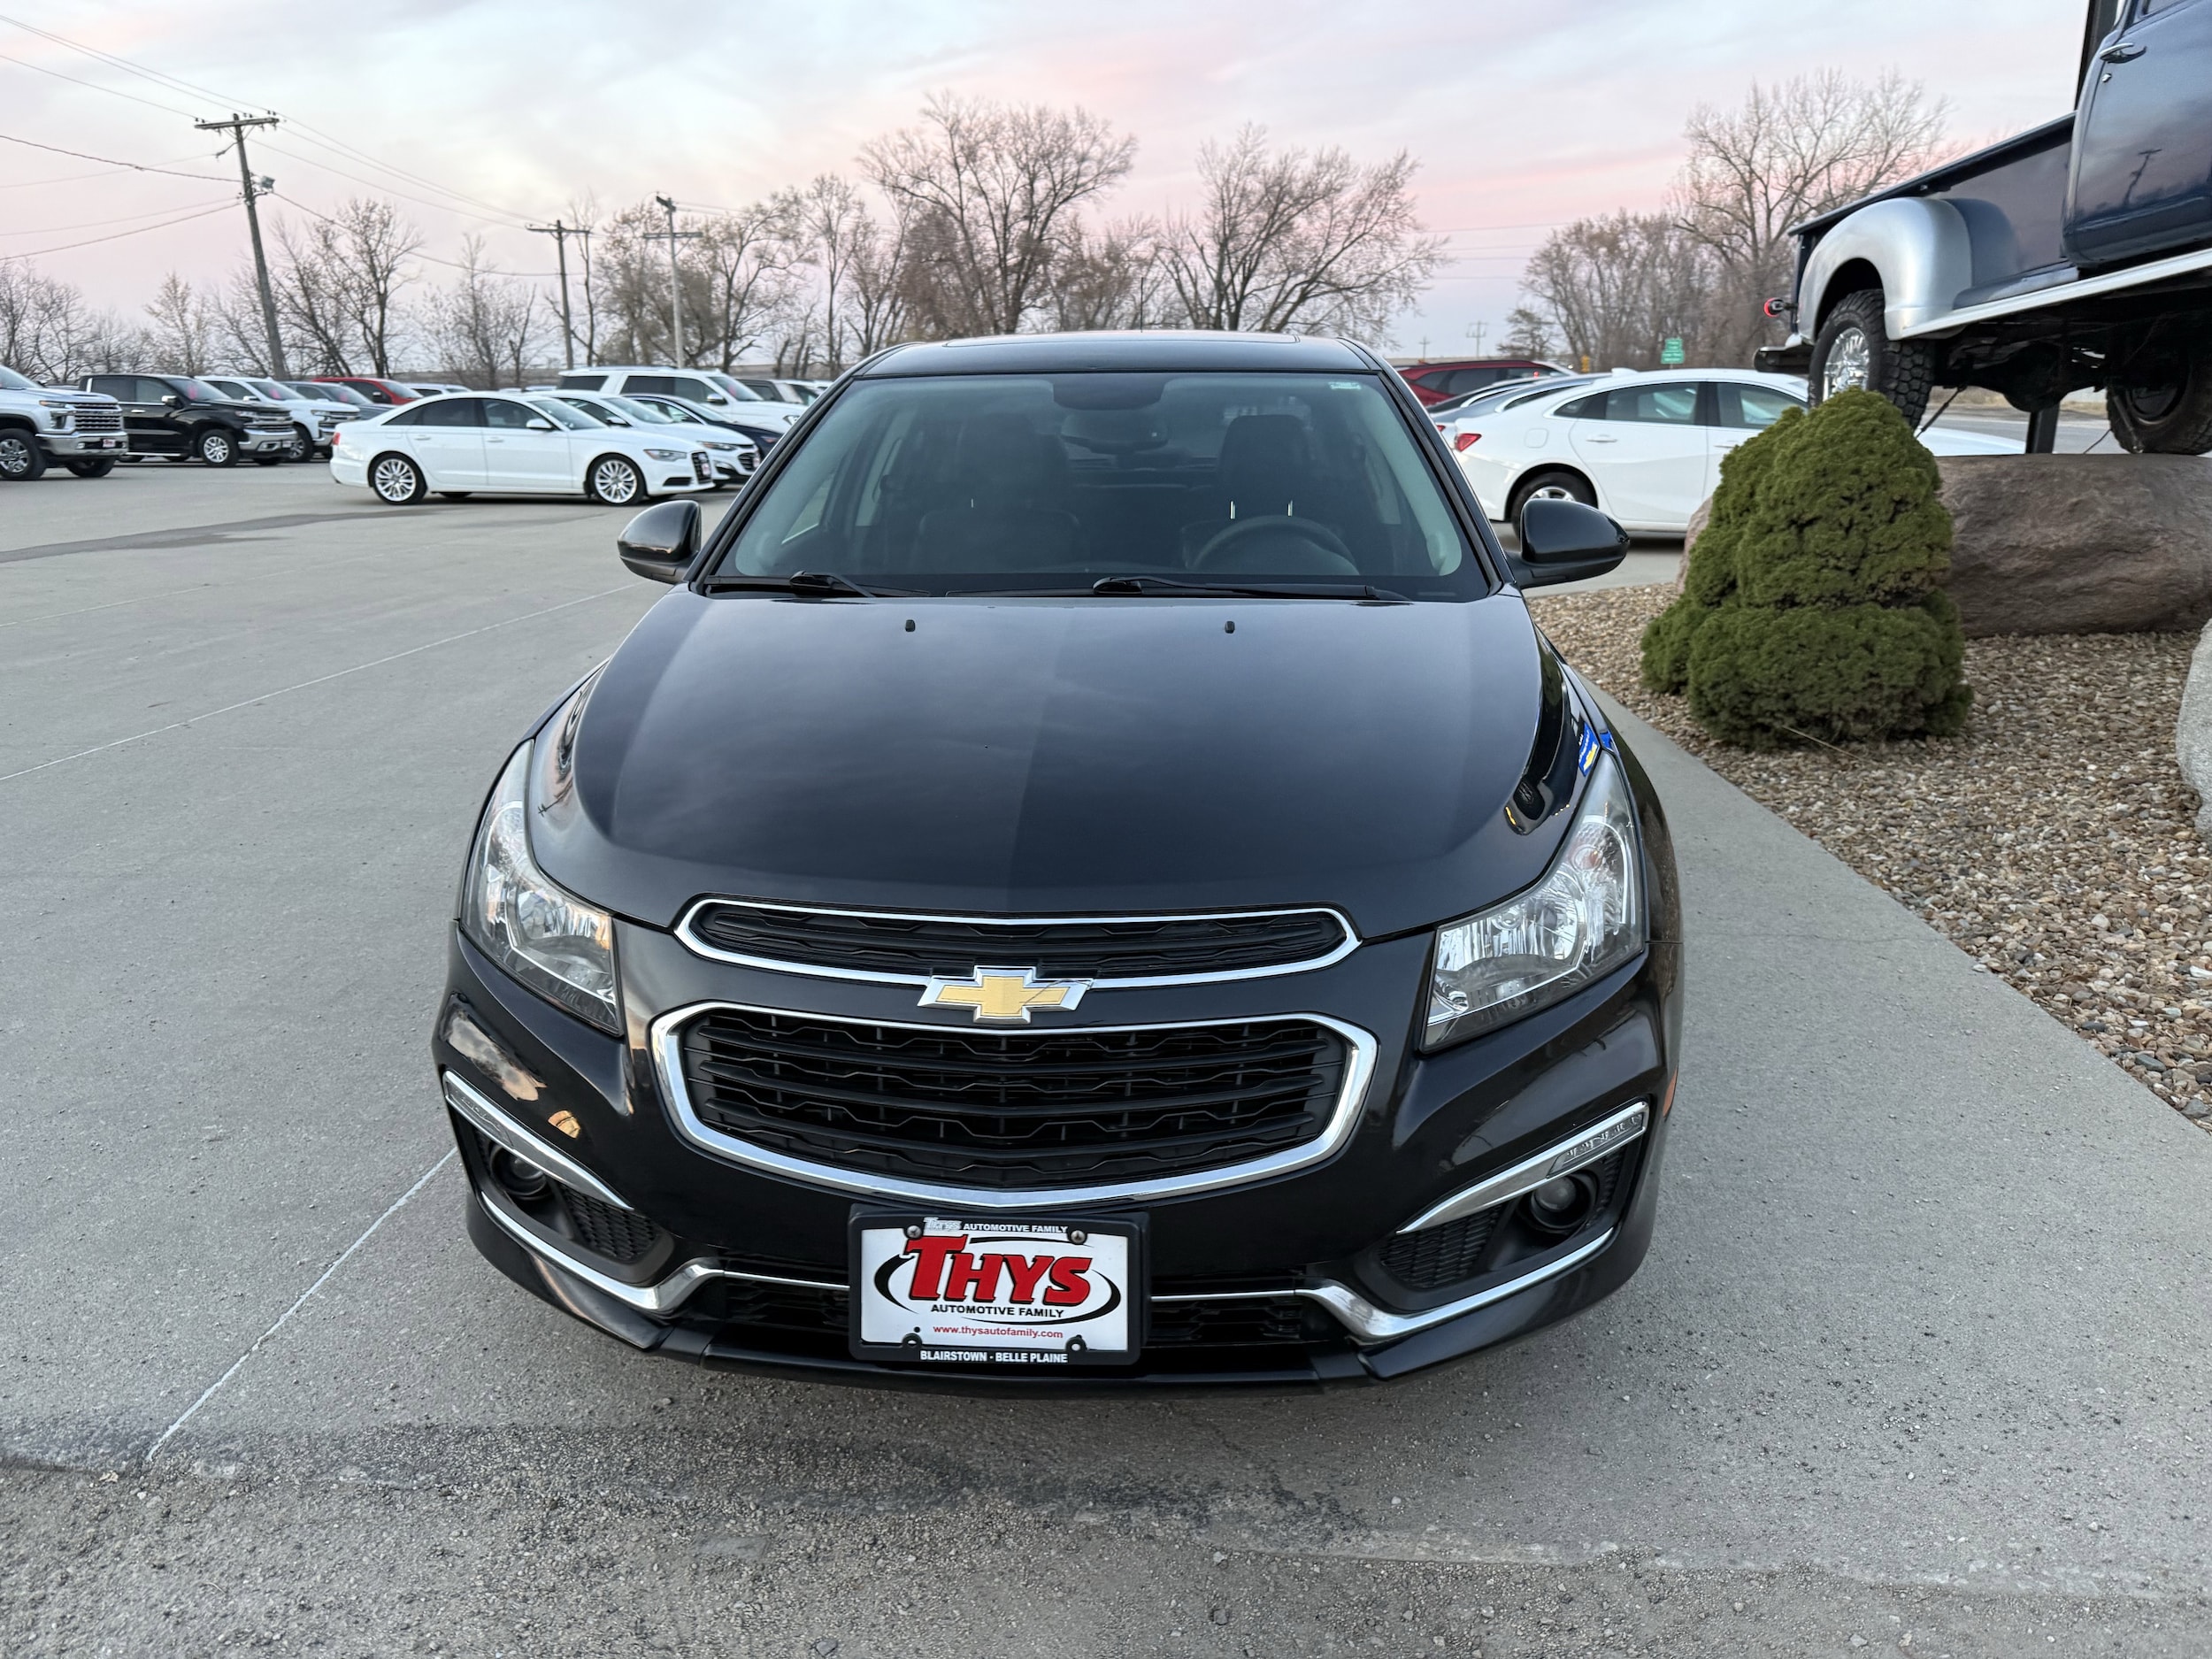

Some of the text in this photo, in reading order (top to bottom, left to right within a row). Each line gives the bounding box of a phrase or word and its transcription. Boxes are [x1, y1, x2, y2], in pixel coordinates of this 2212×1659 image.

[964, 1223, 1029, 1233] AUTOMOTIVE
[1032, 1225, 1068, 1233] FAMILY
[903, 1234, 1093, 1306] THYS
[931, 1304, 1064, 1318] AUTOMOTIVE FAMILY
[933, 1325, 1064, 1339] www.thysautofamily.com
[920, 1350, 987, 1362] BLAIRSTOWN
[995, 1352, 1028, 1363] BELLE
[1030, 1353, 1068, 1363] PLAINE
